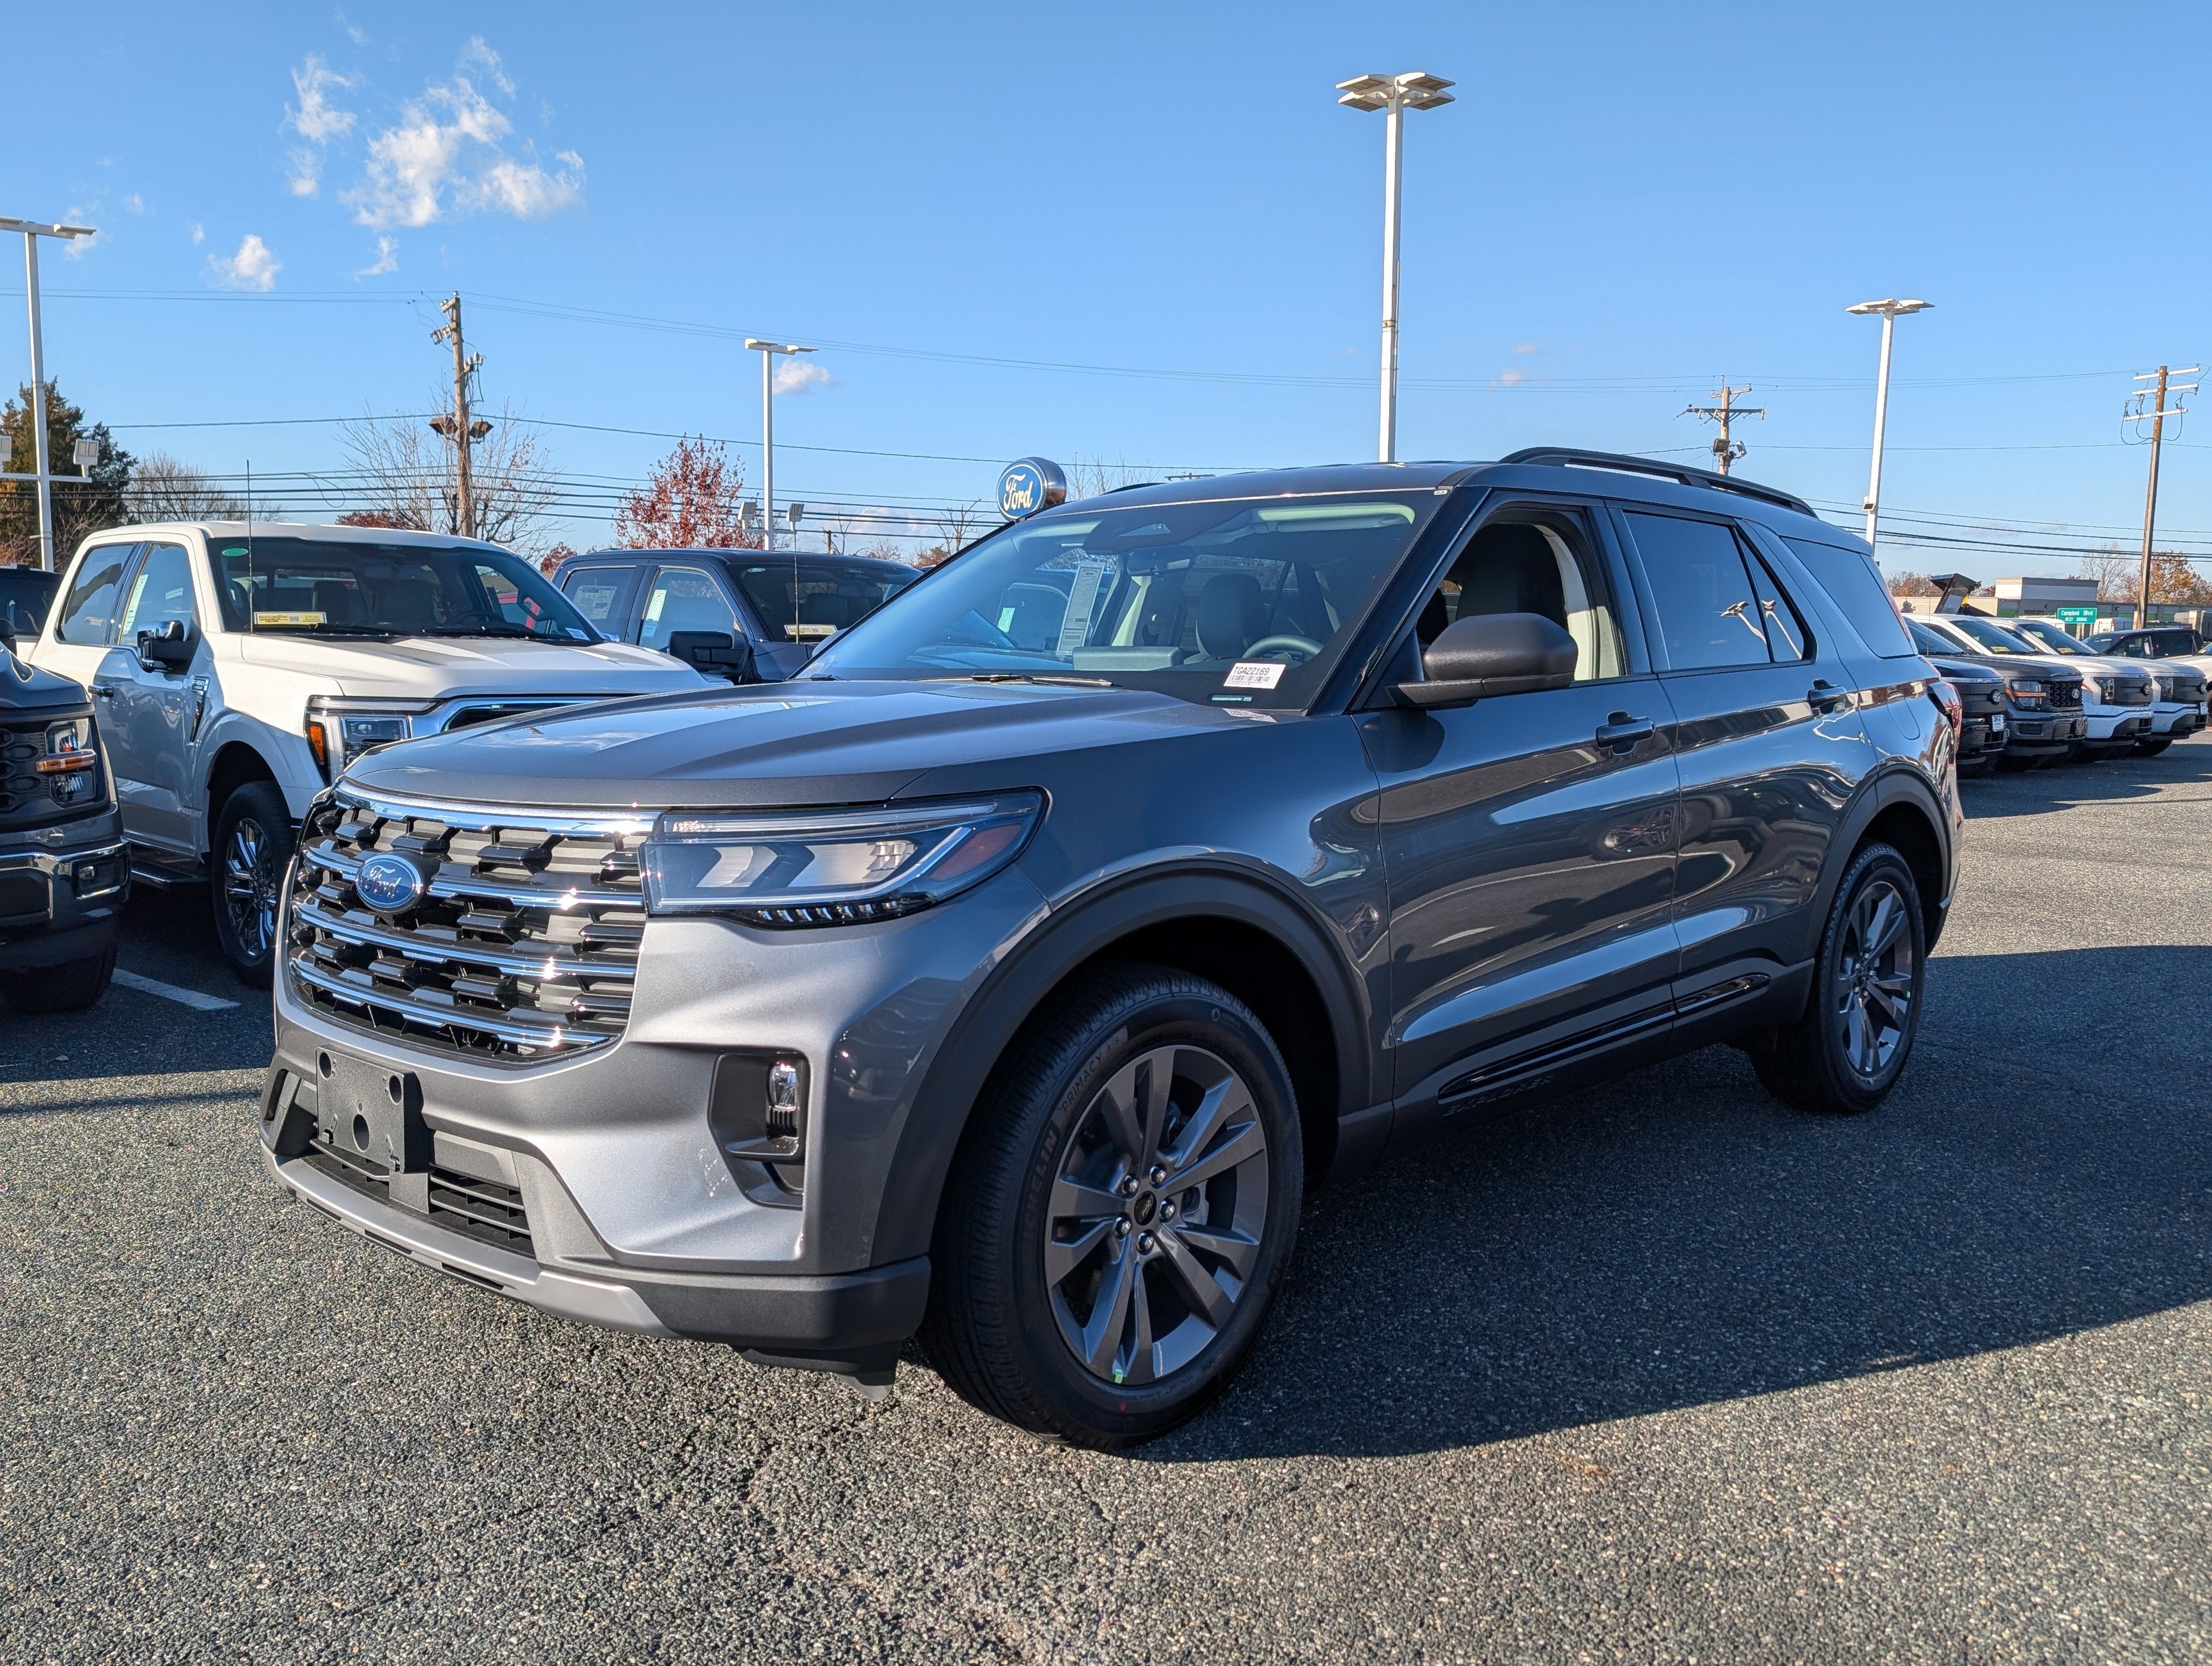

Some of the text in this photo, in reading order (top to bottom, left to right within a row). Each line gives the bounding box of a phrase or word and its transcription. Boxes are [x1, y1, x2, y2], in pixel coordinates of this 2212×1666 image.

[1003, 473, 1033, 511] Ford
[1233, 667, 1270, 675] TGA22169
[365, 865, 402, 898] Ford
[1062, 1051, 1102, 1112] PRIMACY
